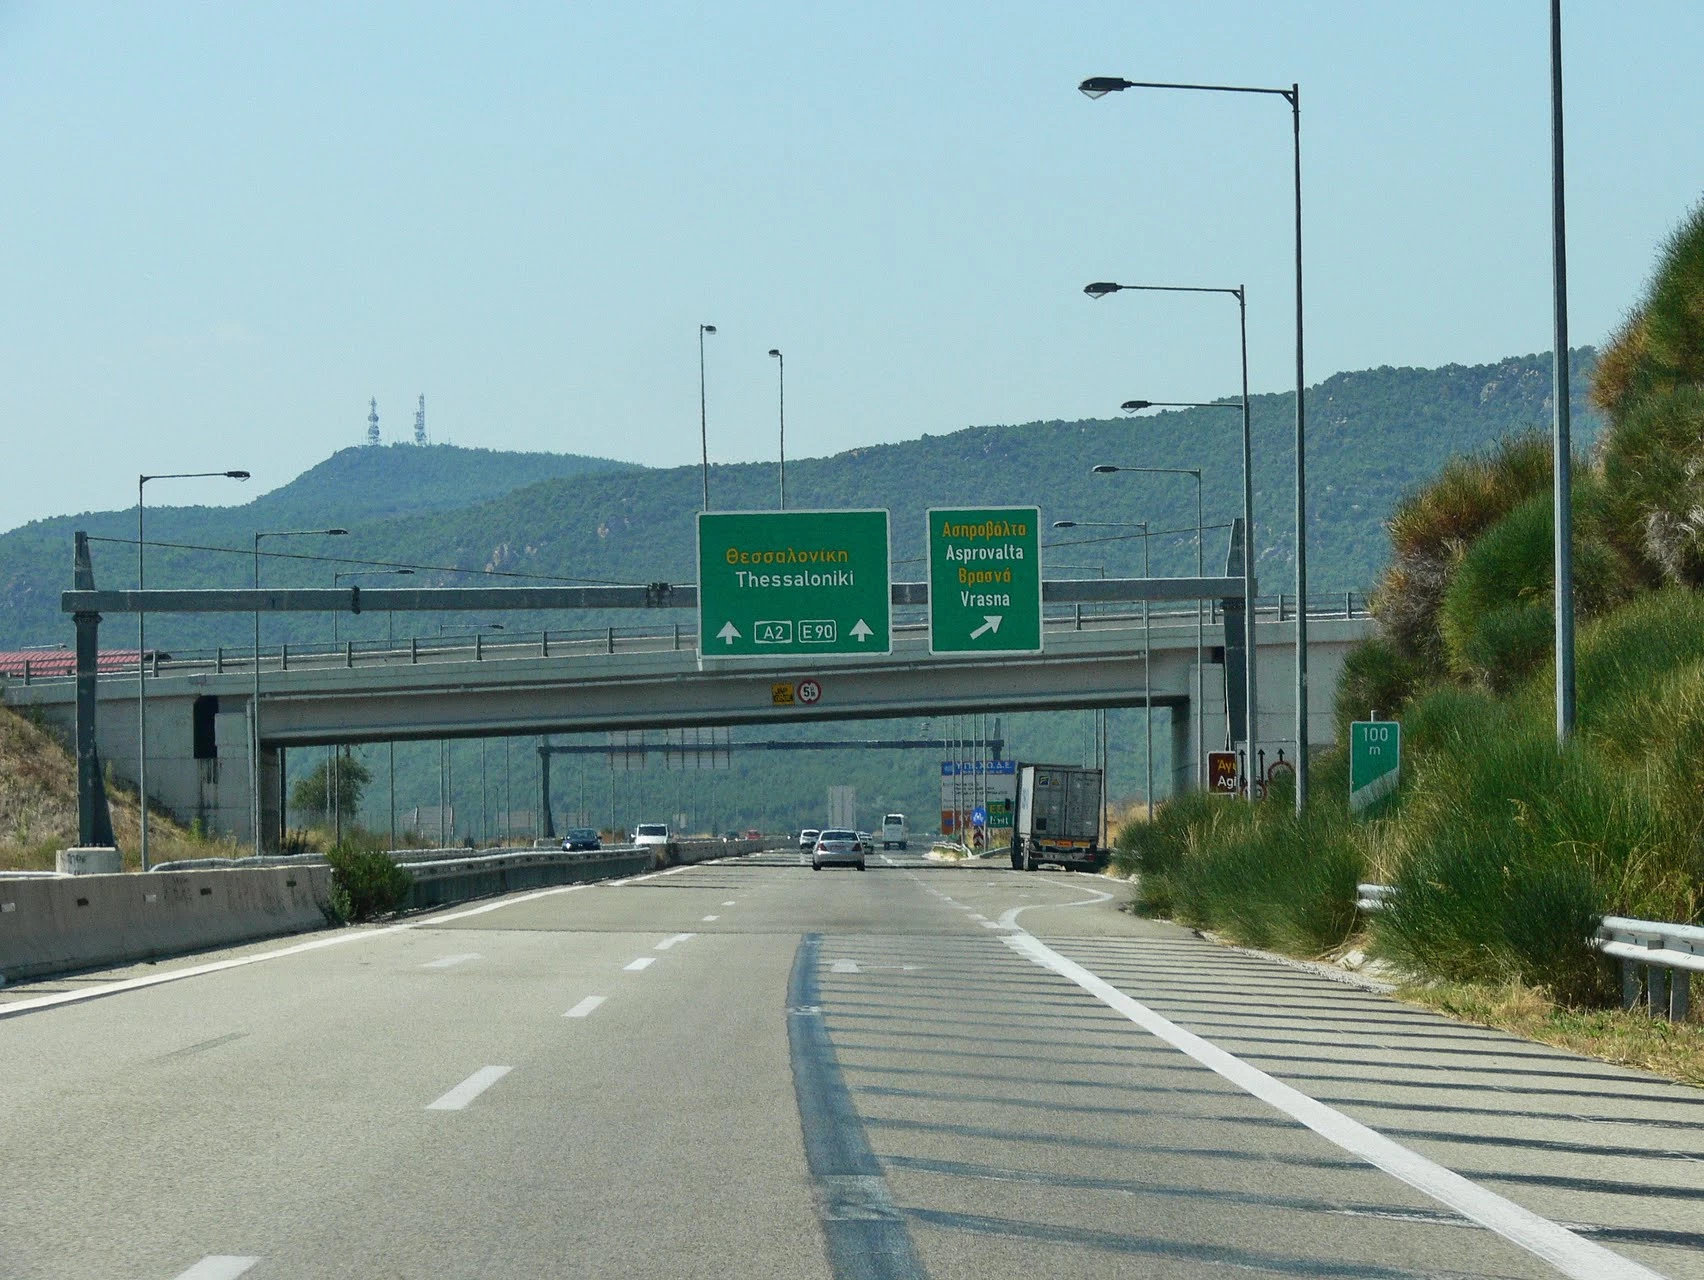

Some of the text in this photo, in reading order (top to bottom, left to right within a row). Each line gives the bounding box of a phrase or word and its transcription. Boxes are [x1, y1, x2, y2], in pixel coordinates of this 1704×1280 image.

[942, 521, 1026, 541] Ασπροβάλτα
[726, 547, 849, 565] Θεσσαλονίκη
[946, 543, 1024, 565] Asprovalta
[735, 570, 854, 588] Thessaloniki
[958, 567, 1012, 588] Βρασνά
[961, 590, 1010, 607] Vrasna
[763, 626, 784, 640] A2
[1363, 727, 1388, 741] 100
[1369, 746, 1381, 755] m
